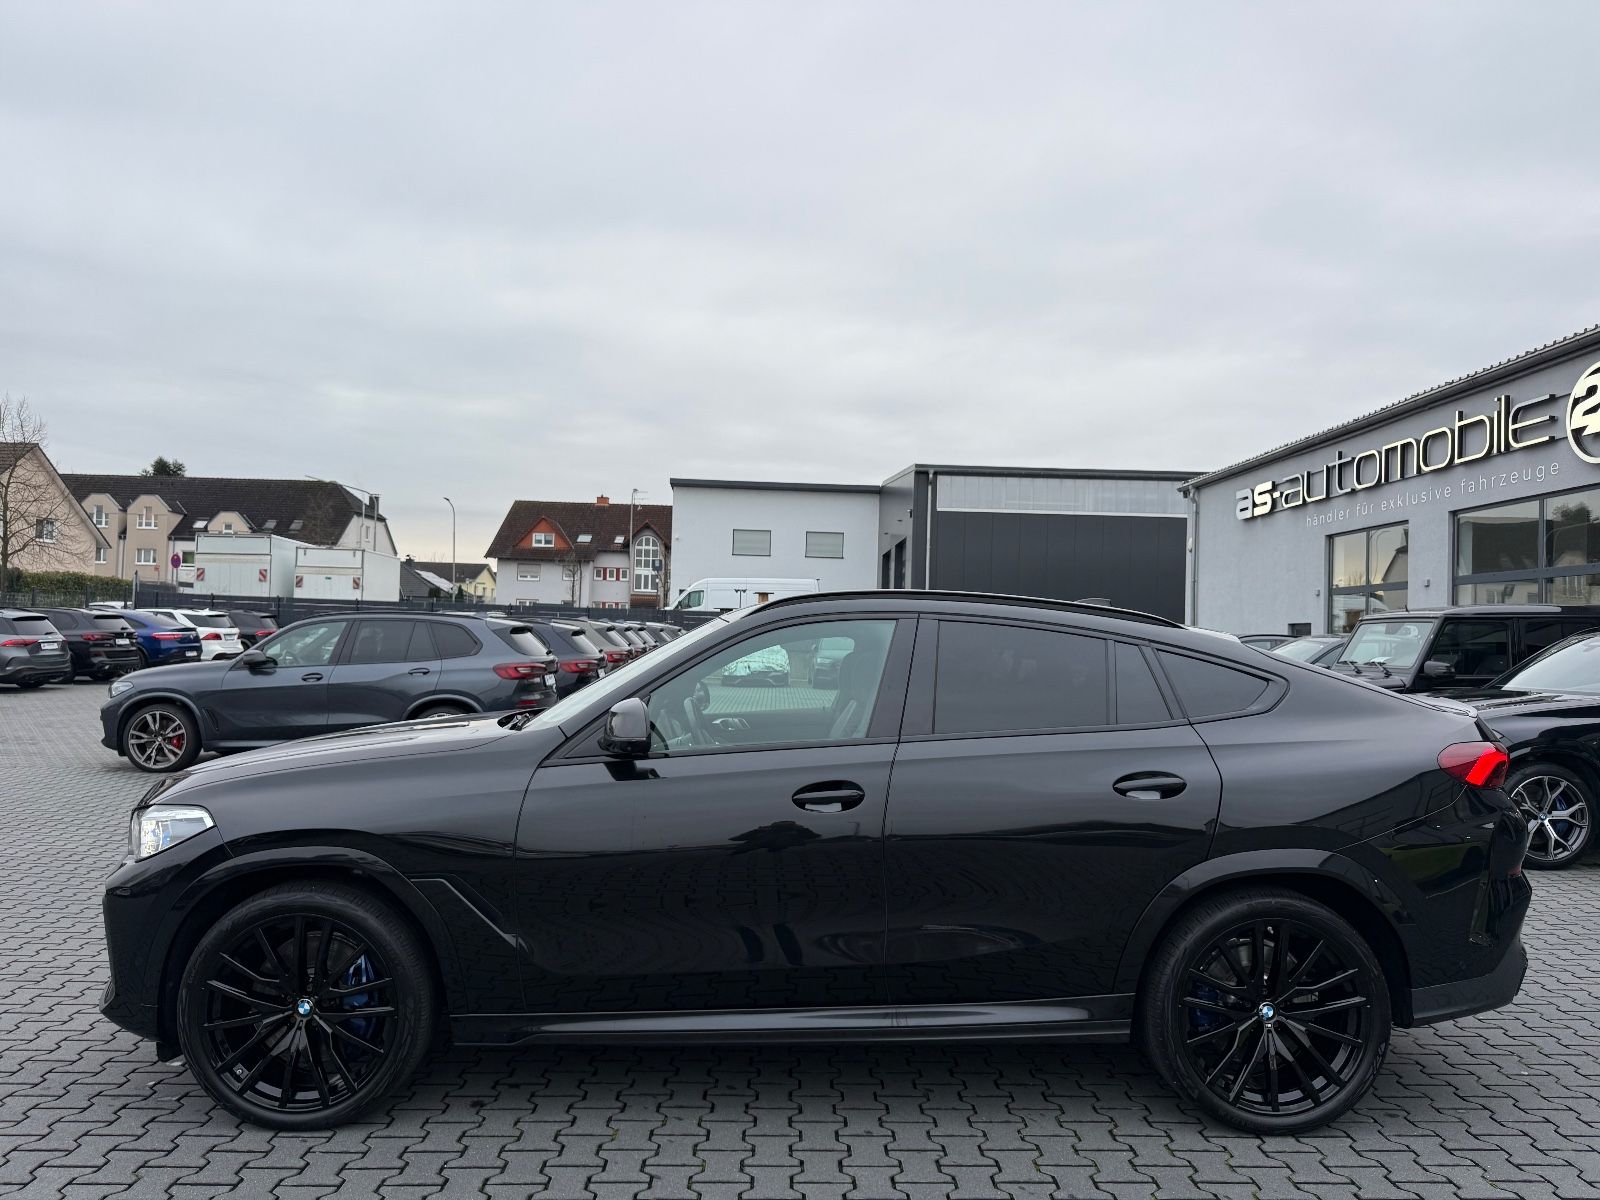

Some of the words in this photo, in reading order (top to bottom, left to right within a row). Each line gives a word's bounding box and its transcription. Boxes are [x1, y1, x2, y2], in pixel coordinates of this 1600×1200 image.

[1306, 507, 1350, 527] händler
[1356, 502, 1374, 517] für
[1381, 486, 1451, 511] exklusive
[1460, 462, 1560, 495] fahrzeuge
